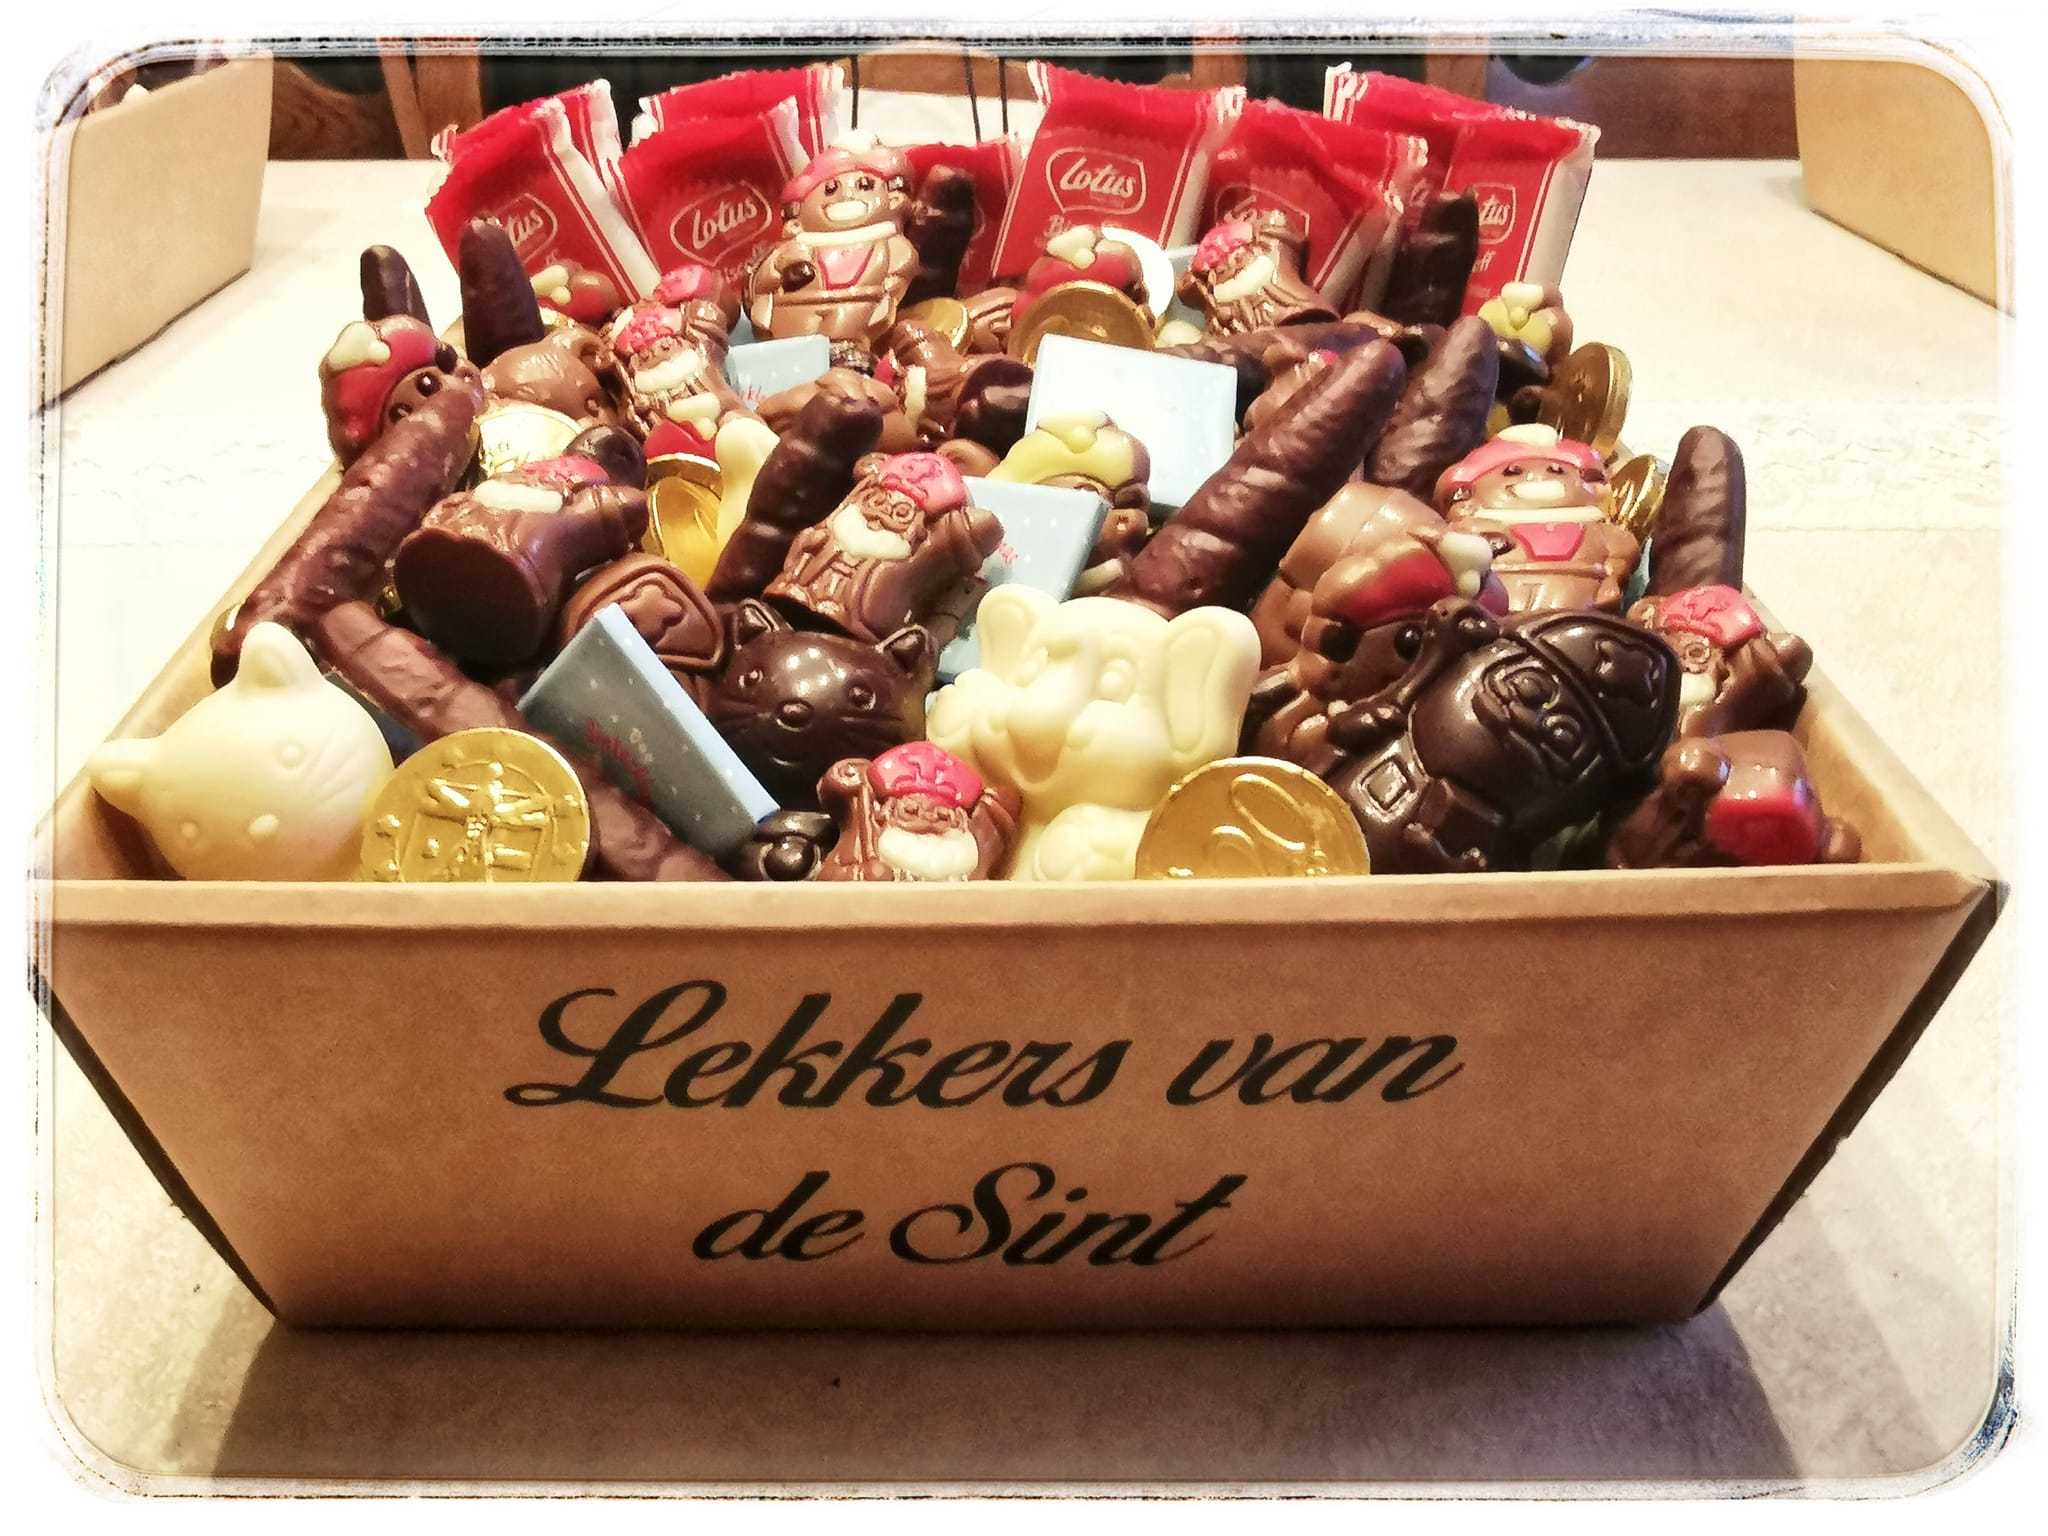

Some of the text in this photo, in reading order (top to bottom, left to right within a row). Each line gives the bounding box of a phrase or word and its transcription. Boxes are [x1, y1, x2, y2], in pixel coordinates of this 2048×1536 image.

[1060, 156, 1136, 199] Lotus
[506, 209, 544, 249] tus
[692, 197, 758, 250] Lotus
[1478, 195, 1510, 226] tus
[503, 979, 1465, 1110] Lekkers van
[690, 1161, 1248, 1267] de Sint
